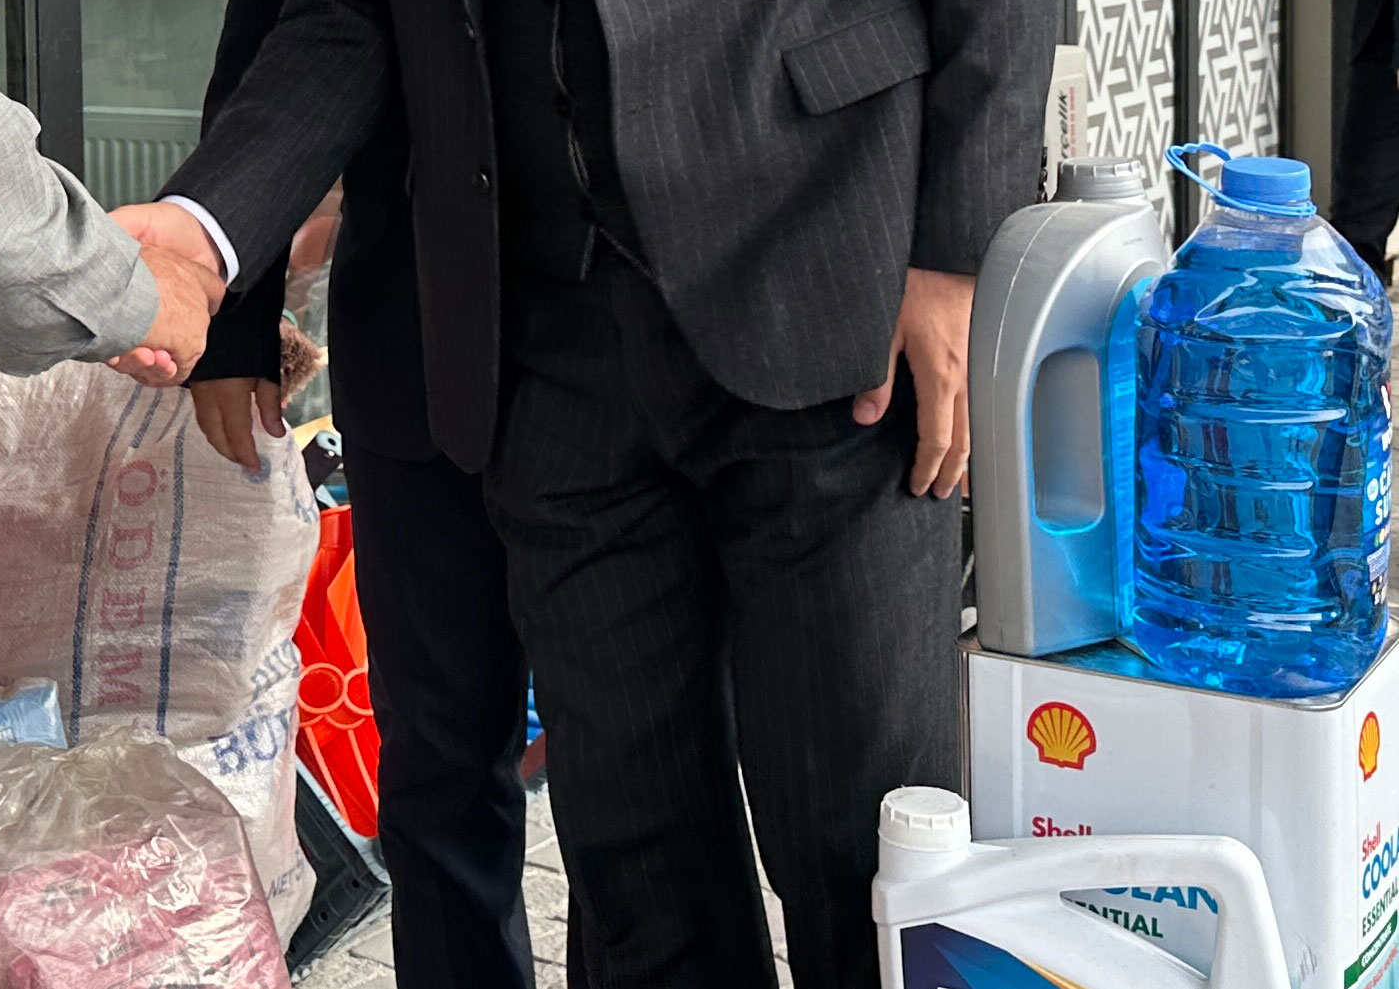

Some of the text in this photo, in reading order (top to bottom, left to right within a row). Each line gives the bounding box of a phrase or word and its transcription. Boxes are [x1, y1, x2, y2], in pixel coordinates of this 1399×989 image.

[98, 458, 169, 712] ÖDEM
[1362, 822, 1381, 862] Shell
[1362, 877, 1399, 938] ESSENTIAL
